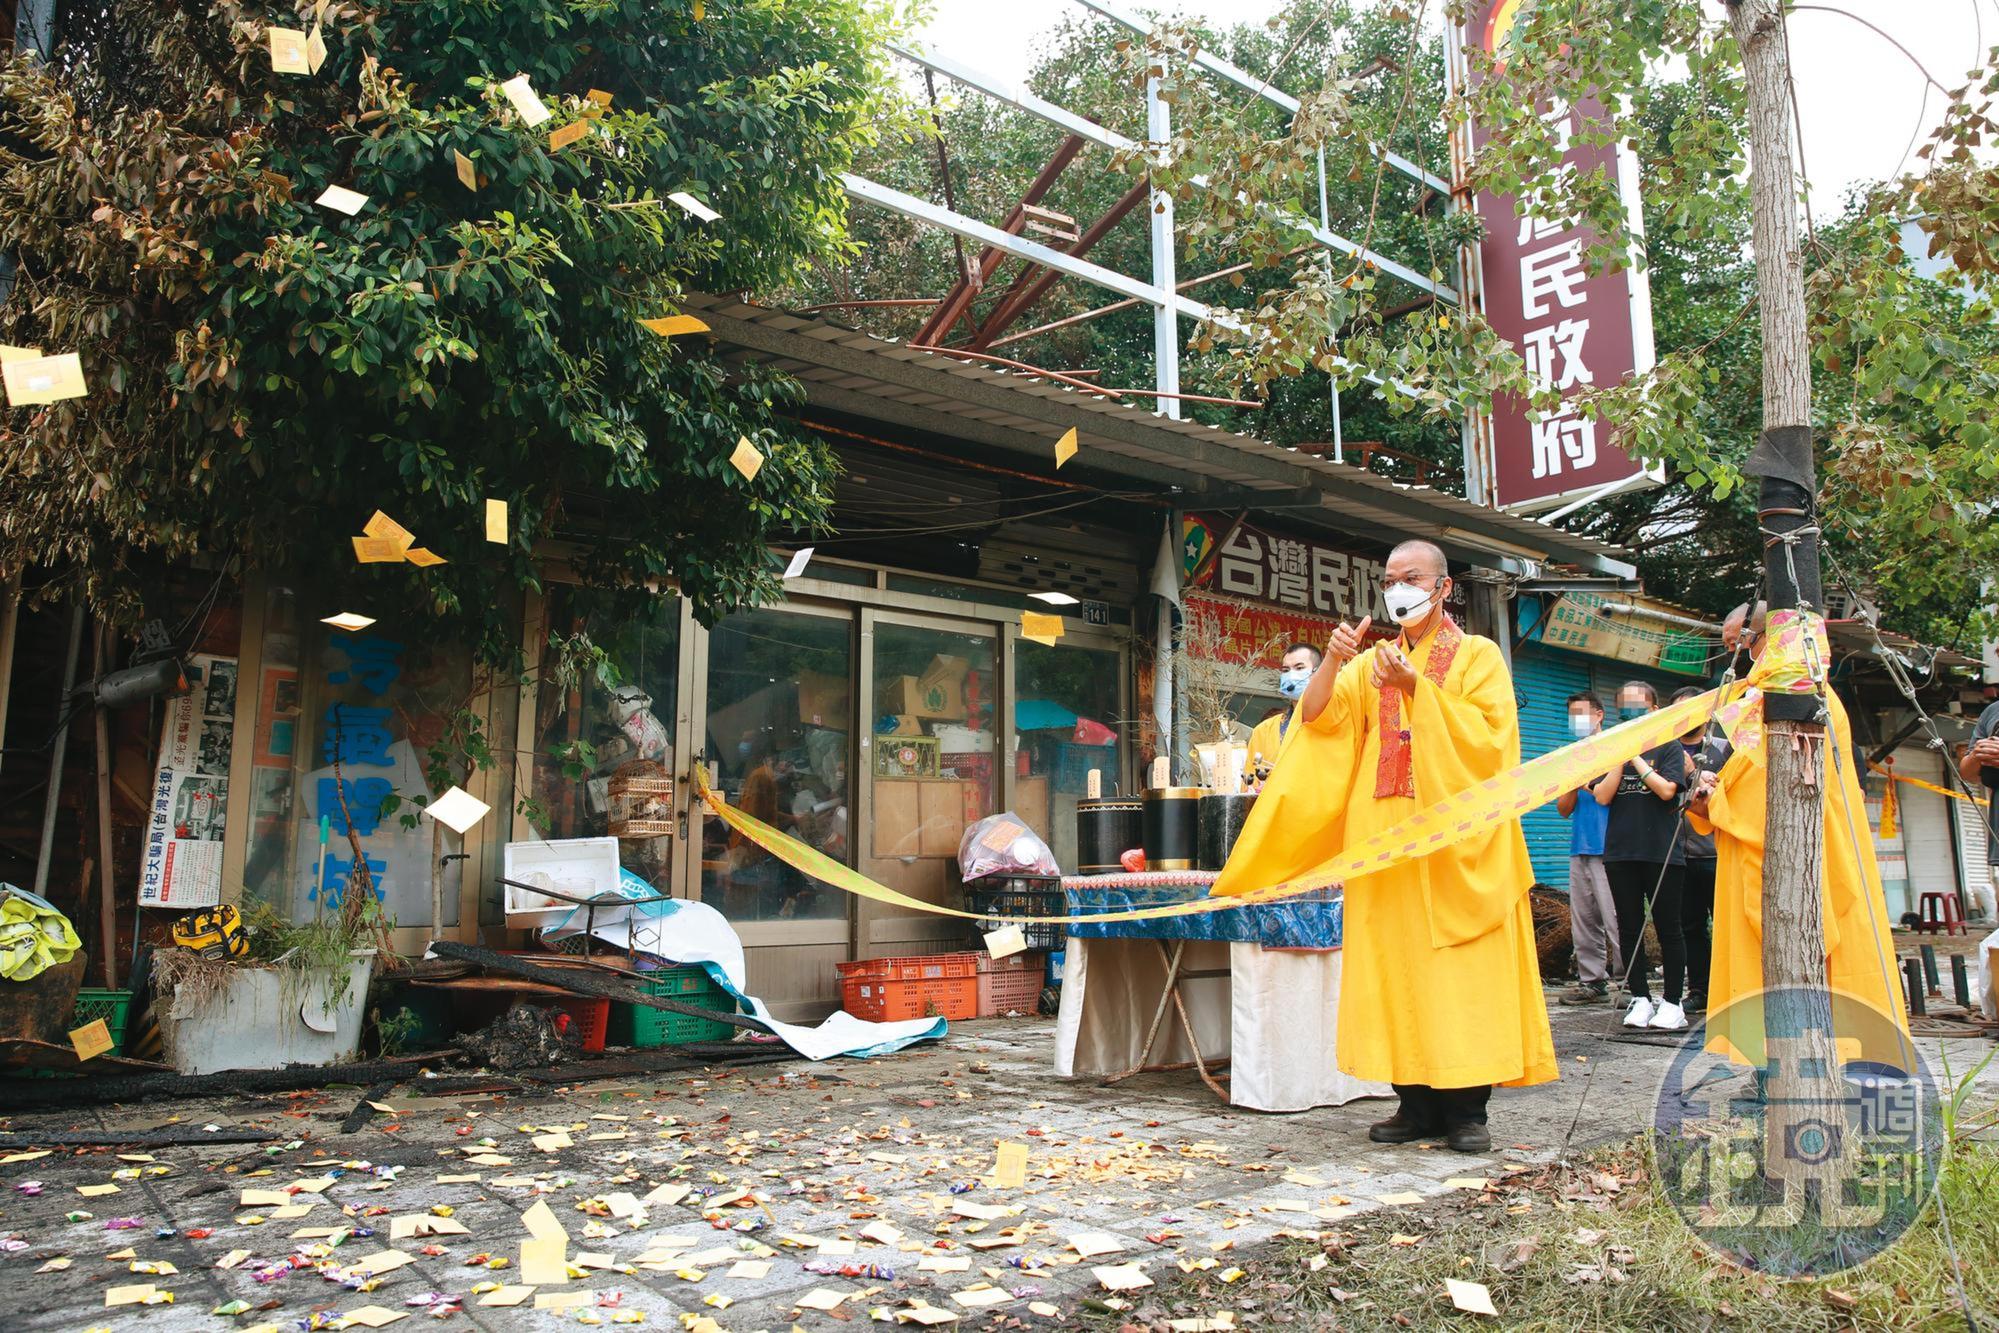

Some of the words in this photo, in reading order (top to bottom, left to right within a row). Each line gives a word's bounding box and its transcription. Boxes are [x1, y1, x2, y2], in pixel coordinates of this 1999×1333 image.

[1510, 95, 1597, 480] 民政府
[1089, 608, 1107, 623] 141
[1221, 526, 1392, 624] 台灣民政
[143, 766, 174, 899] 世紀大騙局(台灣光復)
